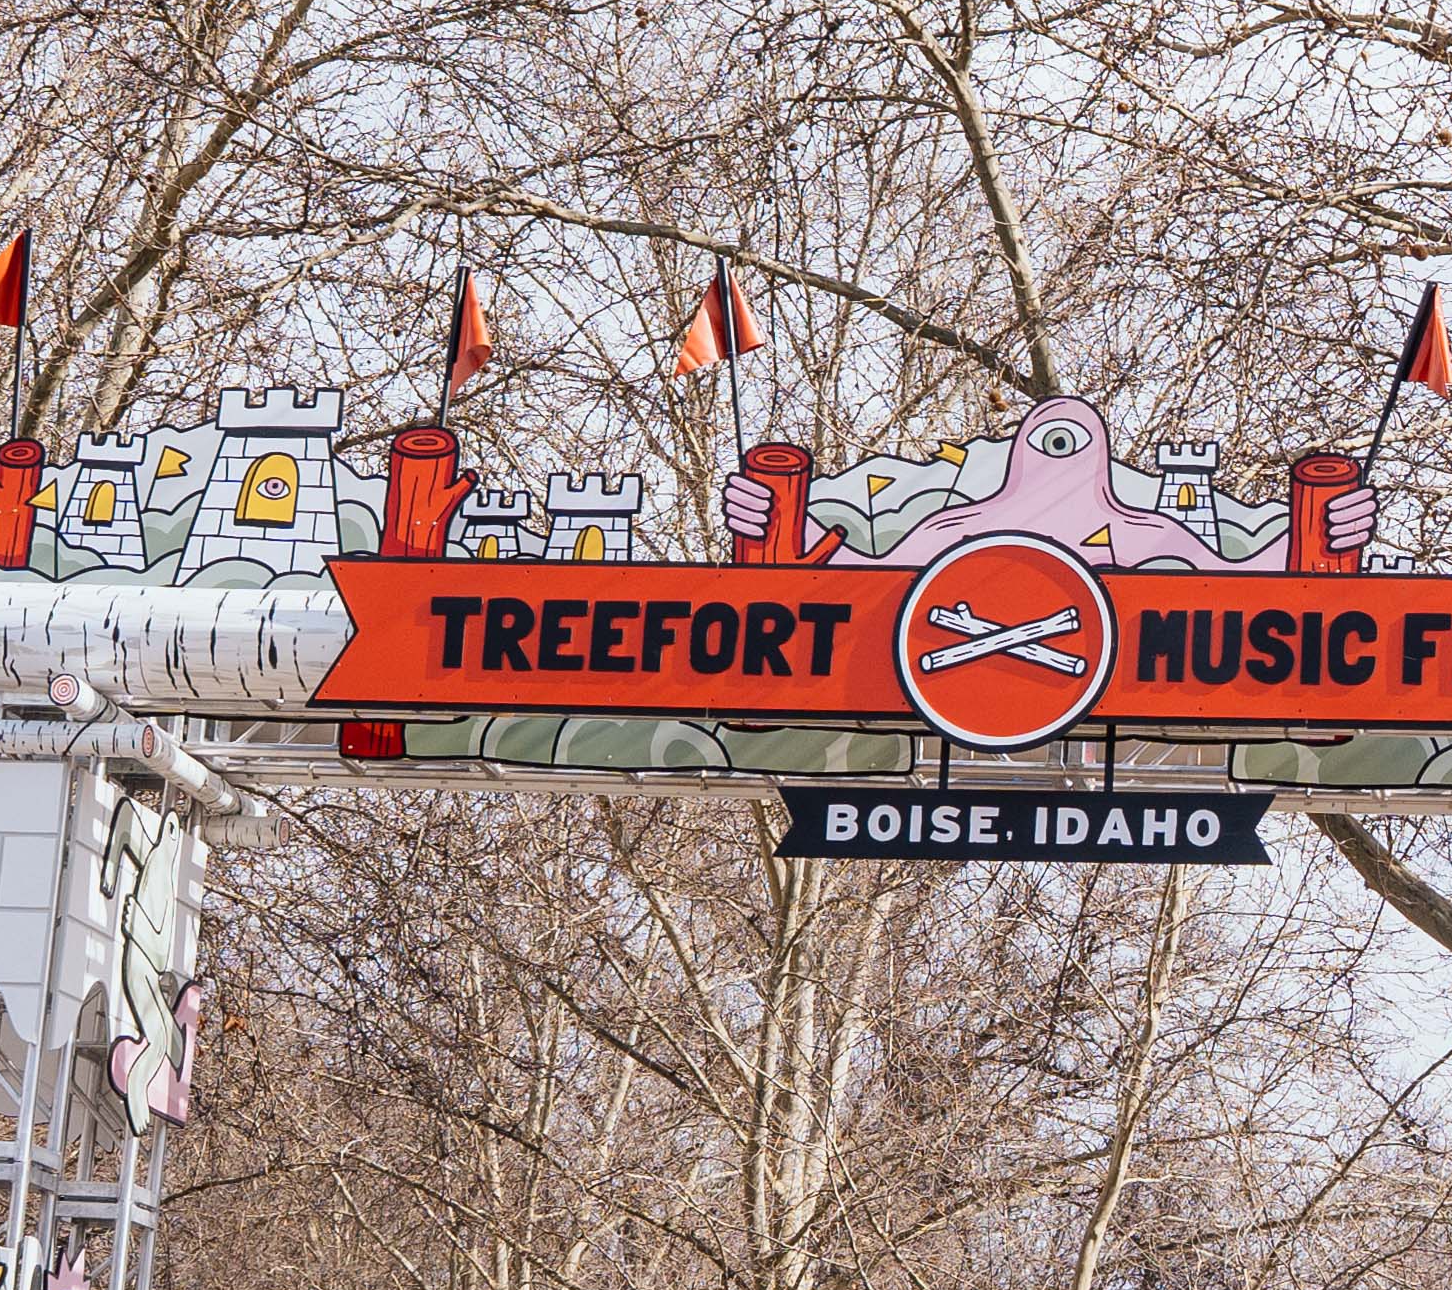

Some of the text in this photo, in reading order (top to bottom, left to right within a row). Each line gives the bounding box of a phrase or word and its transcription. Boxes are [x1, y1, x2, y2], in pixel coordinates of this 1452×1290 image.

[430, 596, 852, 677] TREEFORT
[1137, 609, 1378, 686] MUSIC
[1034, 806, 1221, 847] IDAHO
